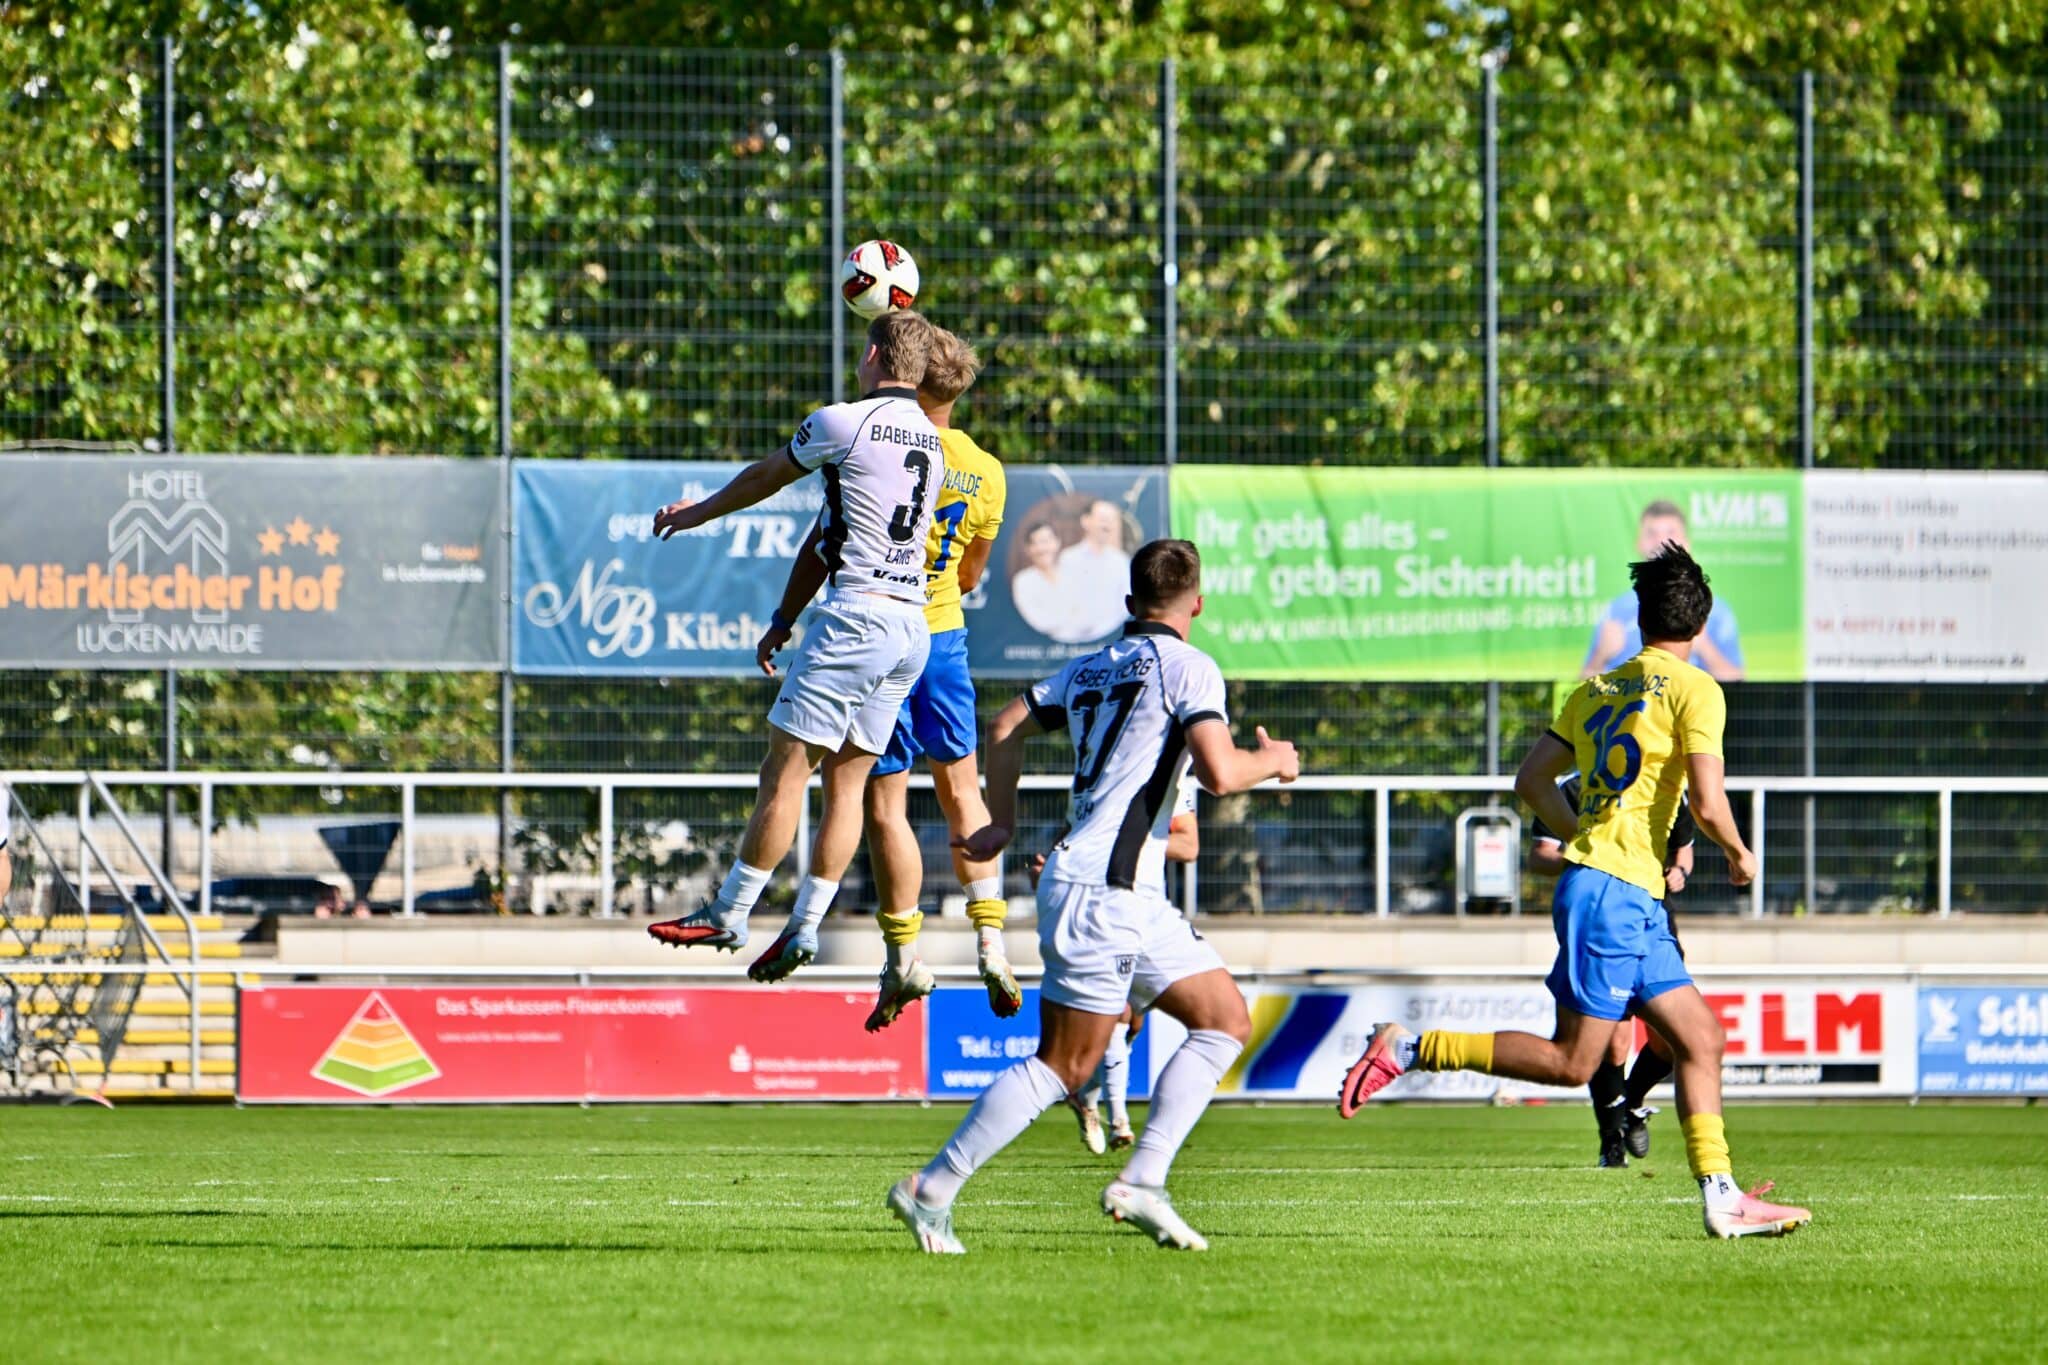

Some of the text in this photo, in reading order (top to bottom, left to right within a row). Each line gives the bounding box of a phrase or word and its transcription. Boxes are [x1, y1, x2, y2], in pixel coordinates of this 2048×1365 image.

[128, 471, 206, 500] HOTEL
[887, 449, 932, 546] 3
[1690, 488, 1755, 527] LVM
[1196, 511, 1243, 547] Ihr
[1253, 511, 1331, 556] gebt
[1343, 511, 1417, 549] alles
[0, 564, 345, 611] Märkischer Hof
[1201, 553, 1598, 606] wir geben Sicherheit!
[77, 623, 263, 655] LUCKENWALDE
[1584, 700, 1646, 792] 16
[436, 997, 468, 1016] Das
[1764, 1064, 1823, 1084] GmbH
